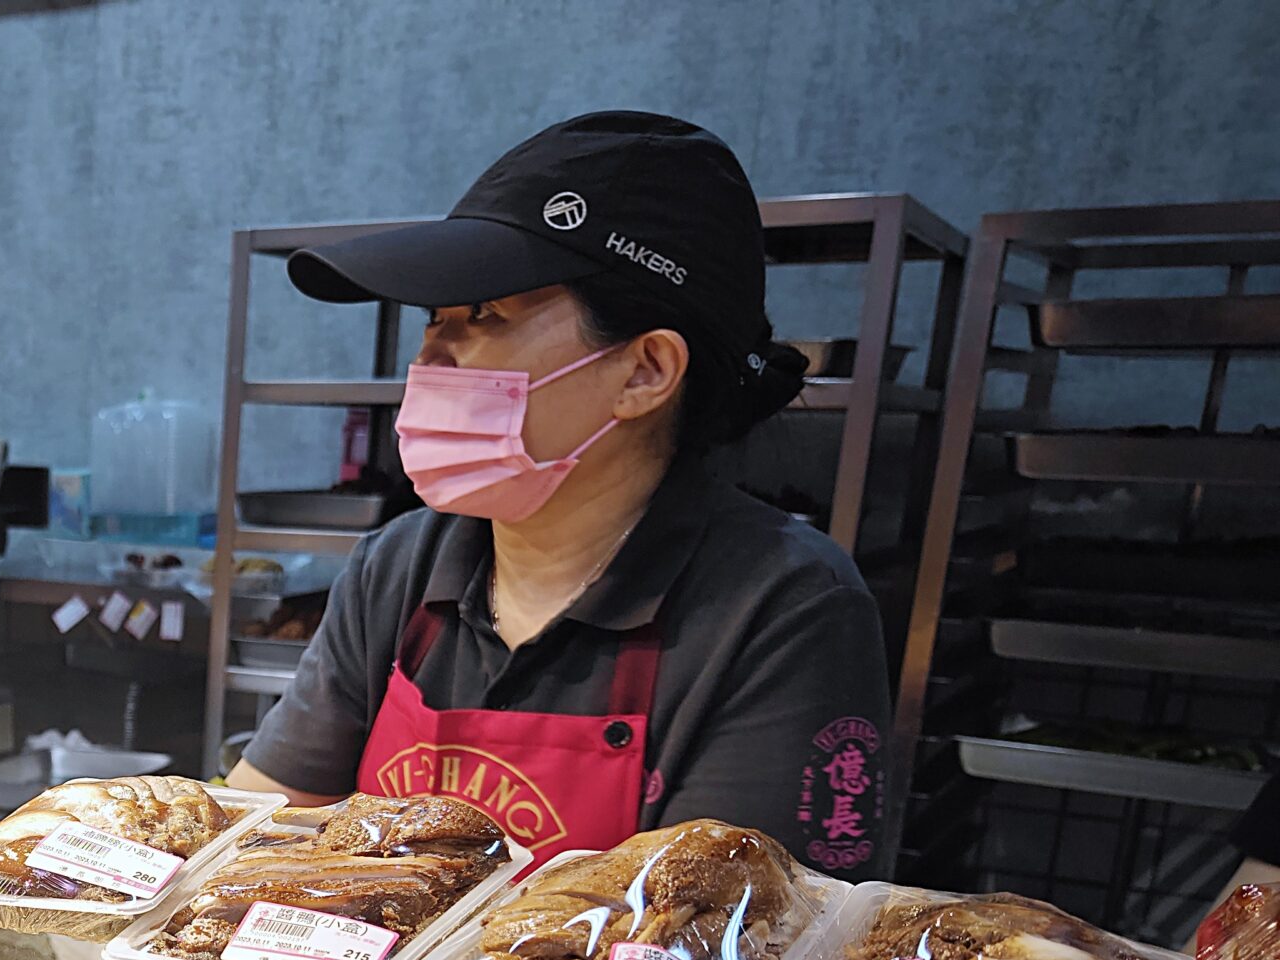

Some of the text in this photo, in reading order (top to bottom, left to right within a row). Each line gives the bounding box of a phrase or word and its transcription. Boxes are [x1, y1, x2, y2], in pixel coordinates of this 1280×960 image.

[605, 231, 688, 285] HAKERS
[823, 743, 871, 839] 億長
[132, 871, 157, 885] 280
[276, 907, 369, 936] 醬鴨(小盒)
[274, 941, 312, 953] 2023.10.11
